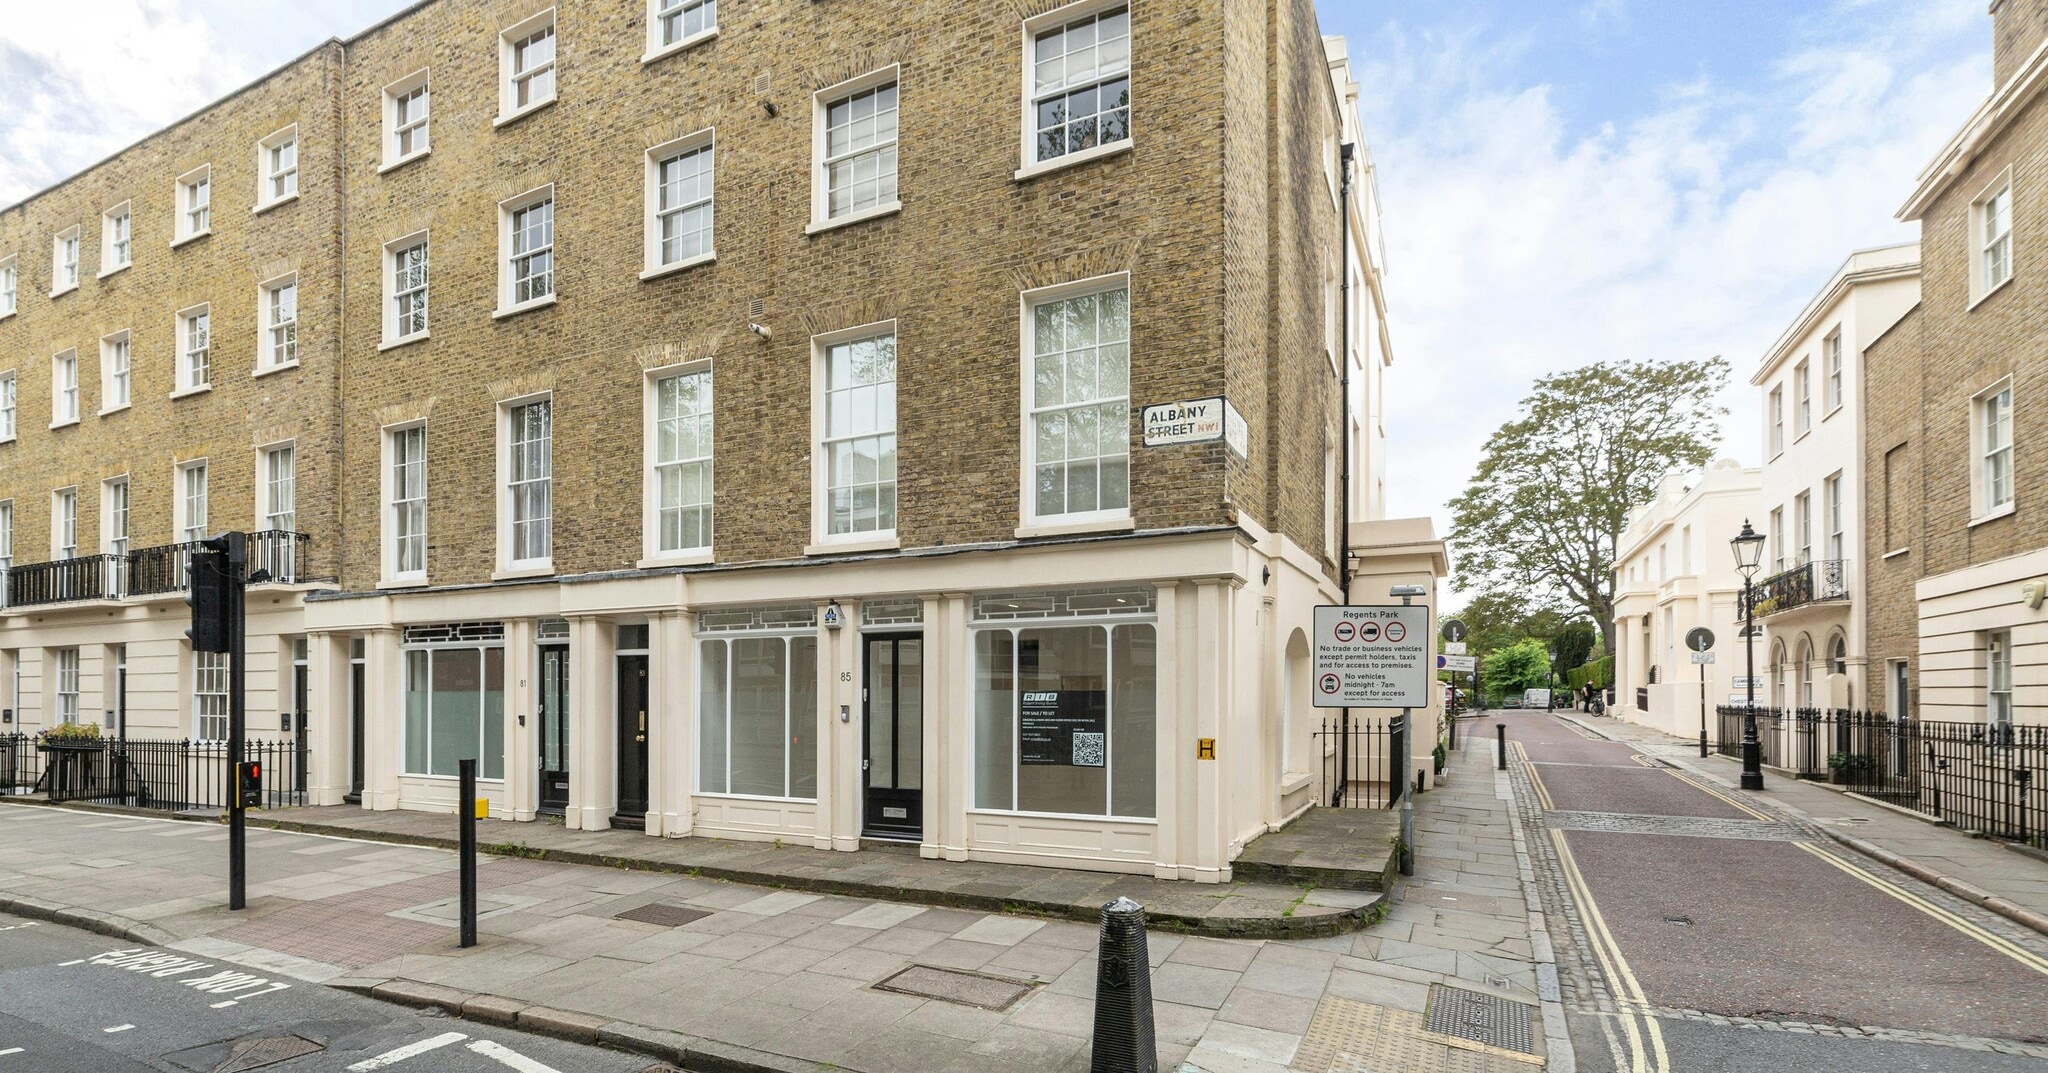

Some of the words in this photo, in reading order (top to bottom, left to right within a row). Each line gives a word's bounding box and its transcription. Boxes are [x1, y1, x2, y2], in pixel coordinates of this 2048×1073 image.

[1150, 406, 1206, 423] ALBANY
[1148, 423, 1195, 438] STREET
[1343, 611, 1377, 619] Regents
[840, 672, 851, 681] 85
[1200, 740, 1213, 757] H
[179, 970, 292, 1000] LOOK
